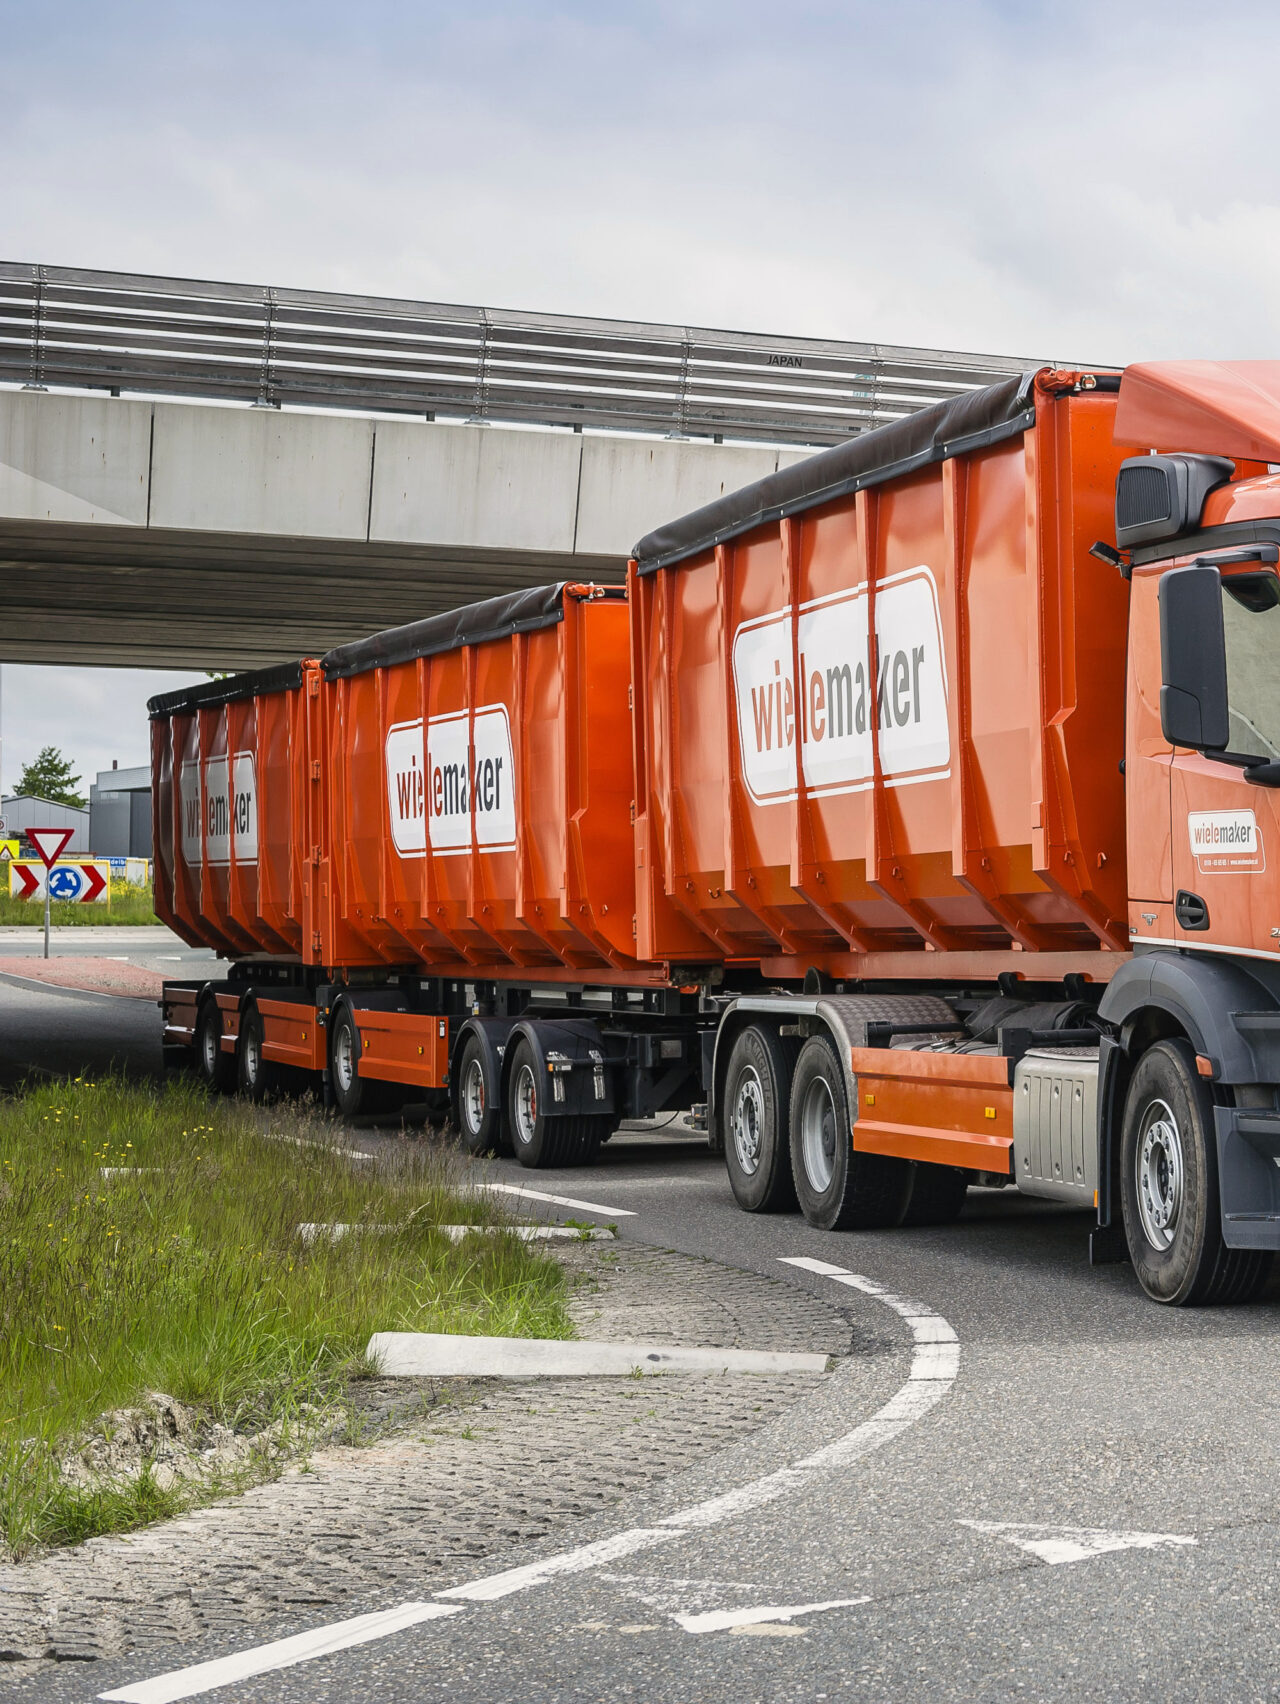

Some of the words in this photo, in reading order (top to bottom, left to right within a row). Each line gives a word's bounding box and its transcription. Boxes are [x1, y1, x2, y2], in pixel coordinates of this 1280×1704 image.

[766, 355, 802, 368] JAPAN
[751, 633, 925, 753] wielemaker
[186, 782, 252, 839] wilemker
[1194, 820, 1252, 845] wielemaker
